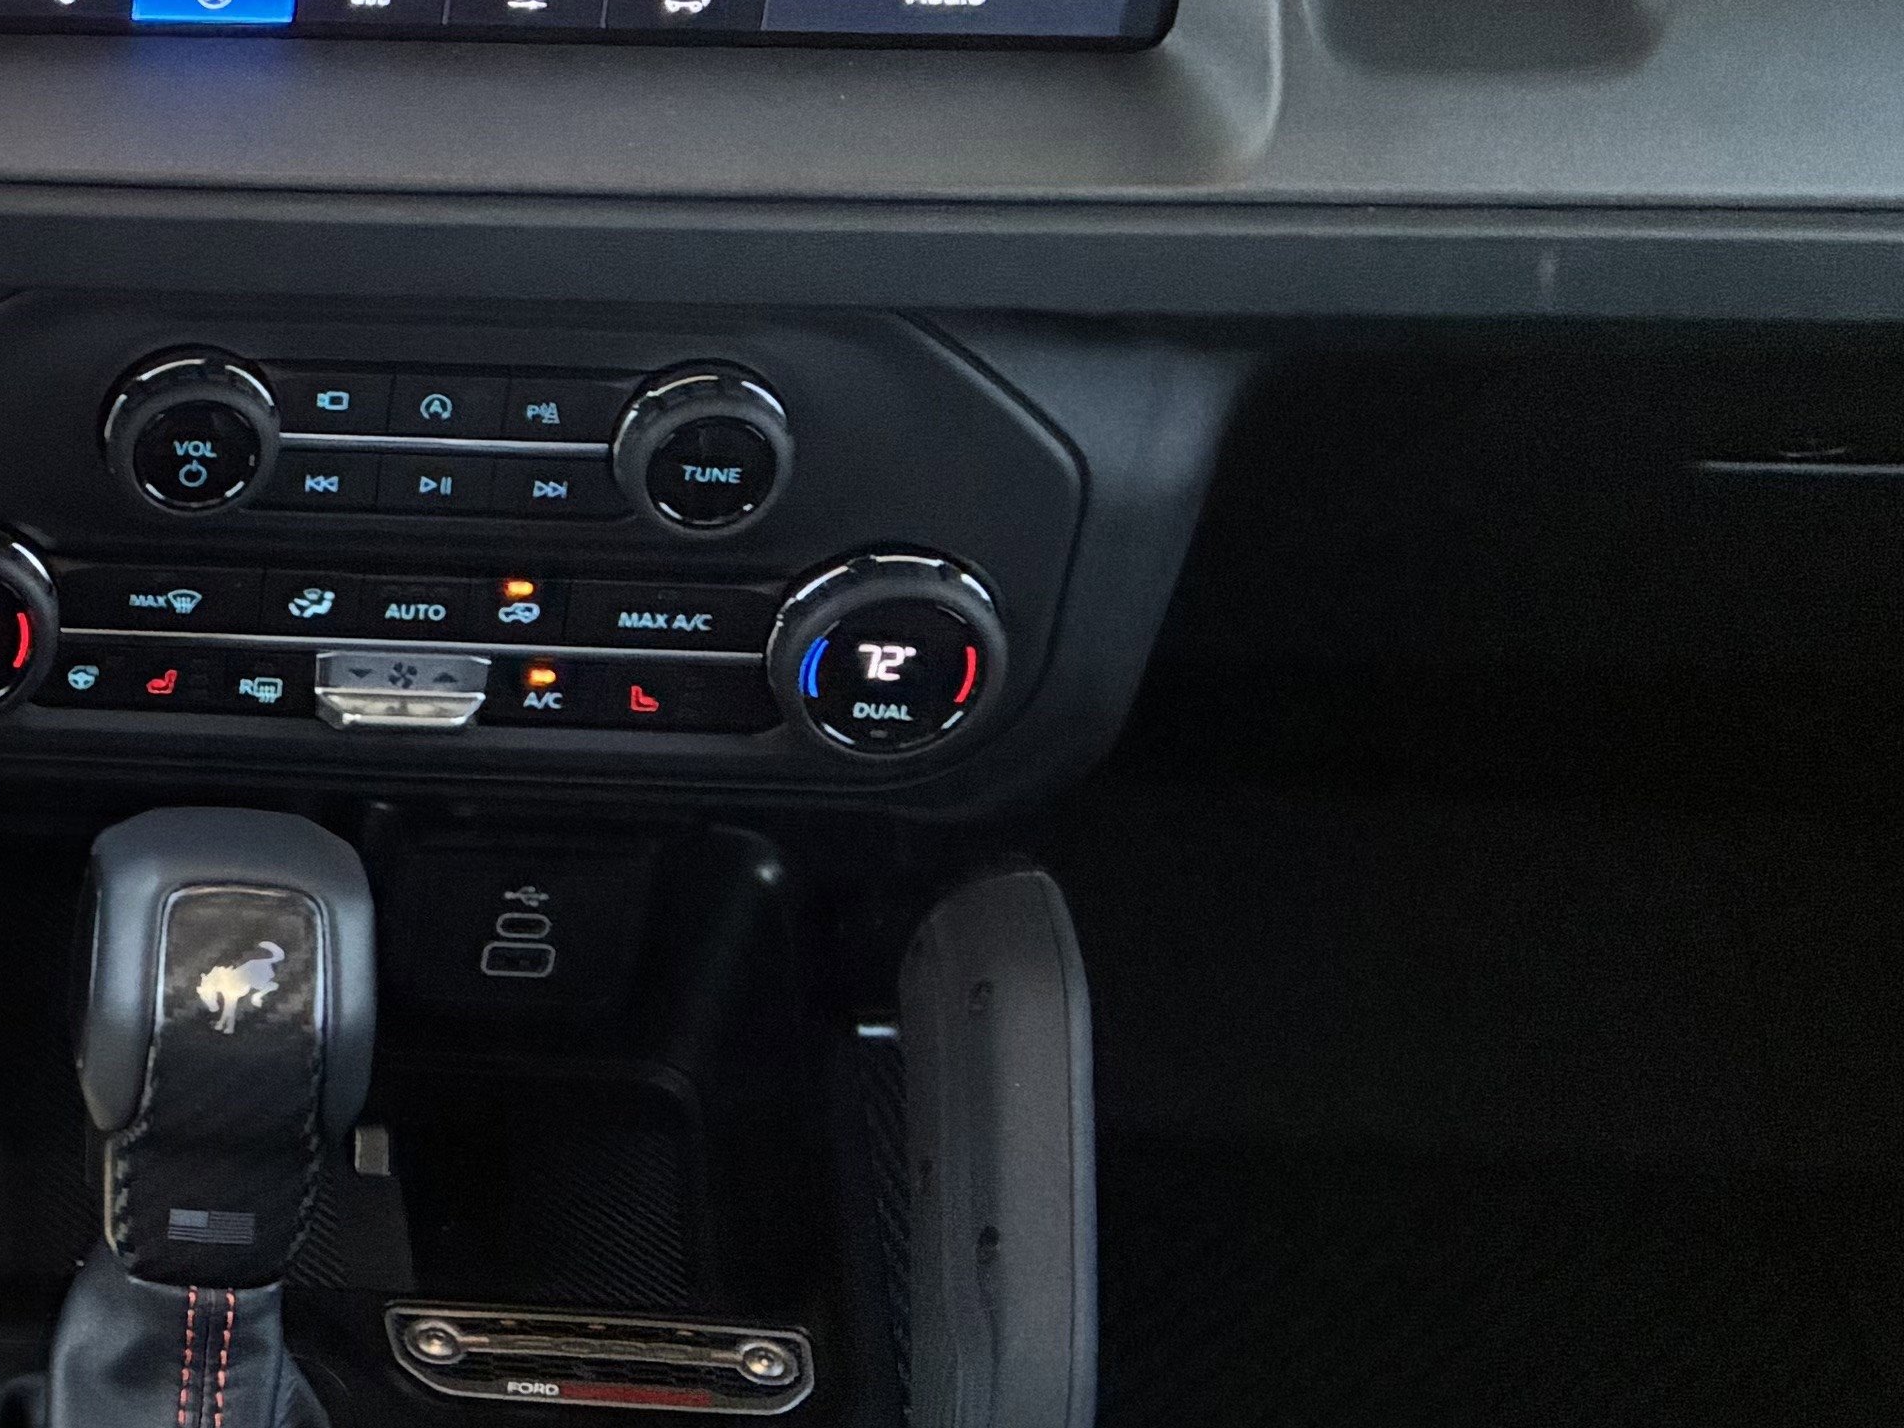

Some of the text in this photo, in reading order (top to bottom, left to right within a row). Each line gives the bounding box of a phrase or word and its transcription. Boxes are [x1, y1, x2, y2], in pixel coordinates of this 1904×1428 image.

[173, 440, 217, 459] VOL
[681, 464, 742, 484] TUNE
[129, 593, 168, 609] MAX
[385, 603, 446, 621] AUTO
[617, 612, 713, 632] MAX A/C
[523, 691, 563, 710] A/C
[852, 702, 913, 721] DUAL
[507, 1380, 559, 1397] FORD
